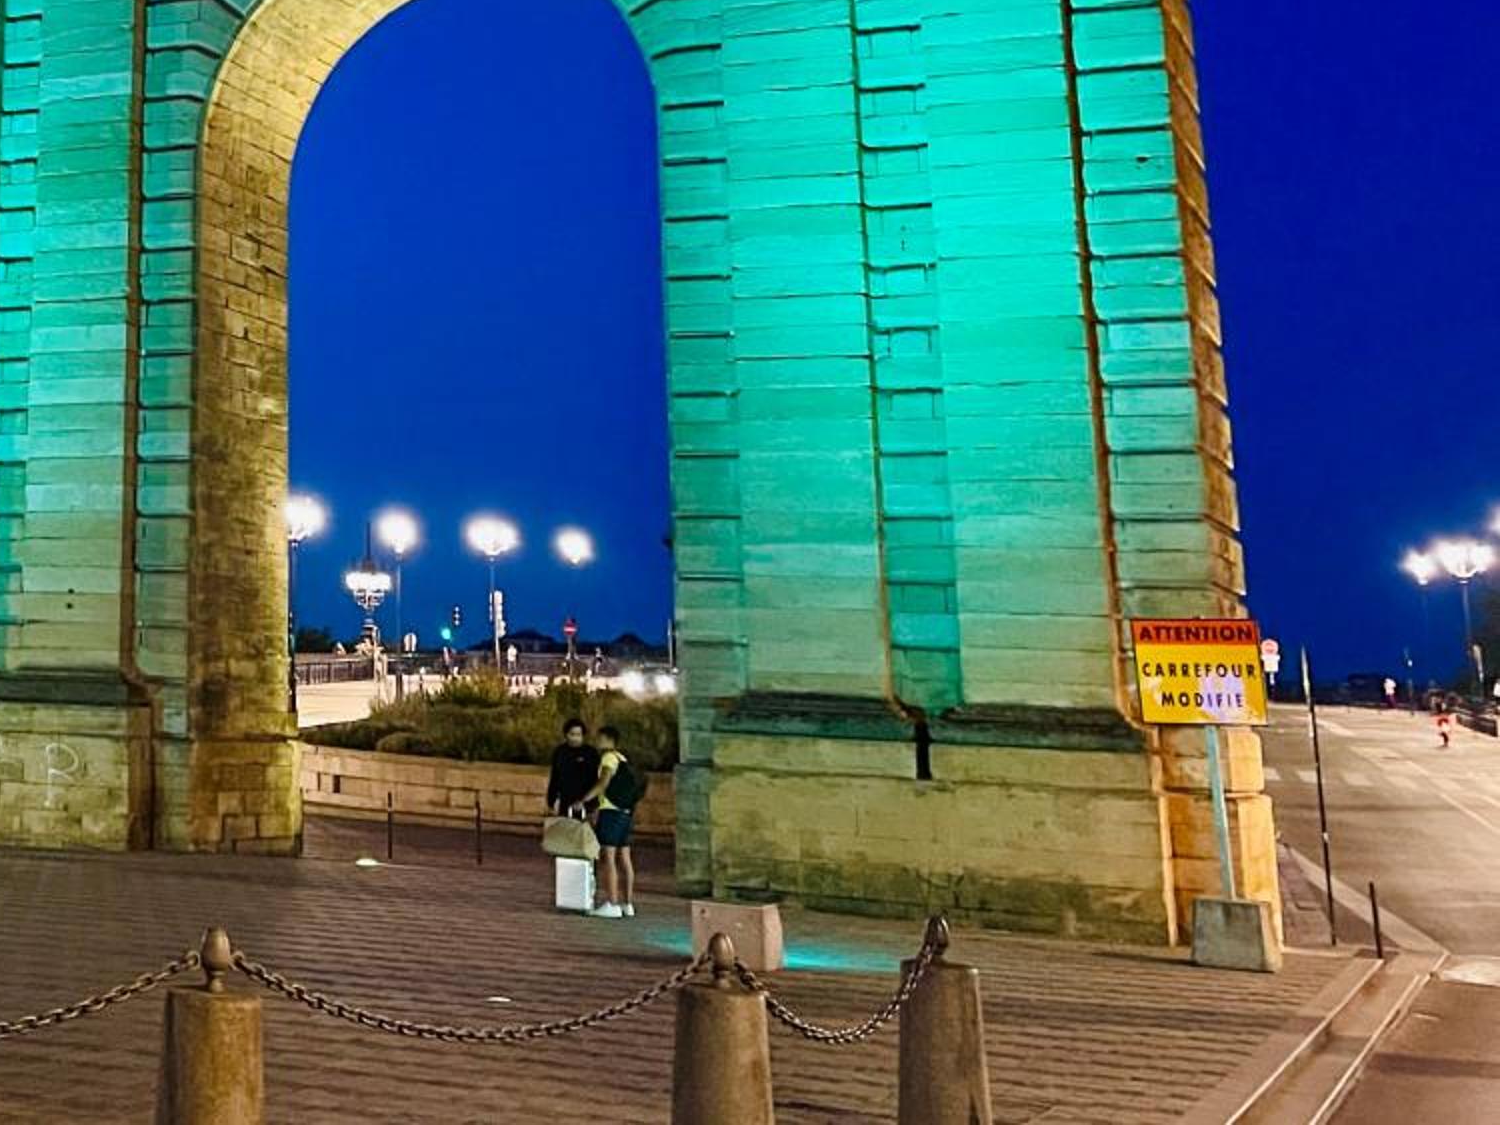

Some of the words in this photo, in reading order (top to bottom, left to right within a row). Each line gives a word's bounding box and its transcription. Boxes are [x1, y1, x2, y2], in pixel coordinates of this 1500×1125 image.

[1139, 626, 1253, 641] ATTENTION
[1142, 662, 1255, 680] CARREFOUR
[1161, 692, 1243, 708] MODIFIE
